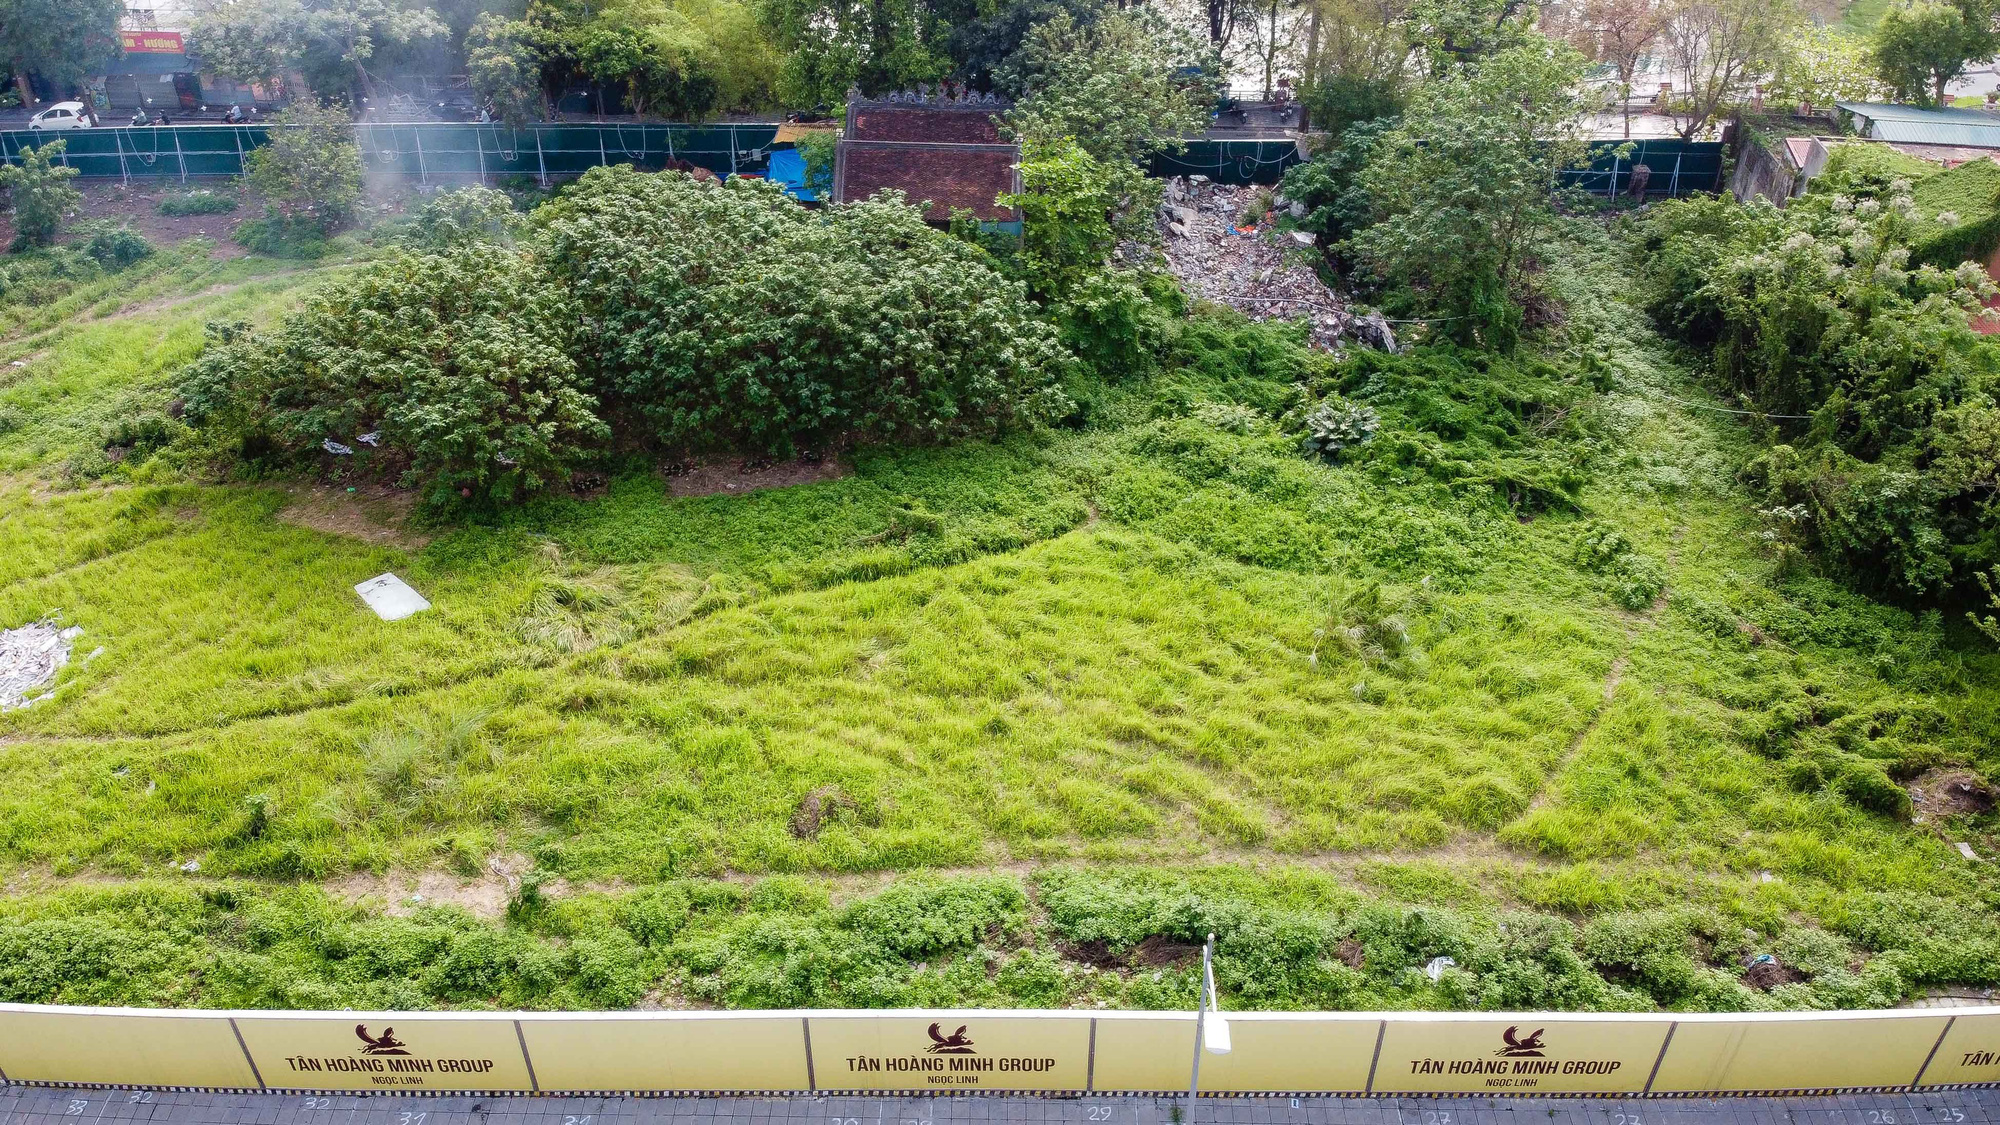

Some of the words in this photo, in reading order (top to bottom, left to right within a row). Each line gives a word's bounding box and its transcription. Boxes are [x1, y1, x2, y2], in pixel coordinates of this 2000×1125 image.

[285, 1055, 323, 1072] TÂN
[324, 1055, 385, 1073] HOÀNG
[388, 1058, 435, 1073] MINH
[438, 1059, 494, 1073] GROUP
[845, 1055, 881, 1072] TÂN
[886, 1055, 944, 1072] HOÀNG
[949, 1057, 994, 1072] MINH
[999, 1057, 1056, 1072] GROUP
[1410, 1057, 1445, 1074] TÂN
[1448, 1057, 1508, 1075] HOÀNG
[1511, 1060, 1560, 1075] MINH
[1562, 1060, 1622, 1075] GROUP
[1961, 1050, 1995, 1067] TÂN
[371, 1076, 399, 1087] NGỌC
[400, 1076, 424, 1085] LINH
[927, 1075, 954, 1086] NGỌC
[956, 1075, 979, 1084] LINH
[1485, 1078, 1513, 1088] NGỌC
[1514, 1078, 1539, 1087] LINH
[129, 1090, 153, 1105] 32
[304, 1097, 330, 1110] 32
[65, 1099, 89, 1116] 33
[1087, 1106, 1112, 1121] 29
[400, 1111, 427, 1125] 31
[1868, 1109, 1895, 1125] 26
[1939, 1108, 1965, 1123] 25
